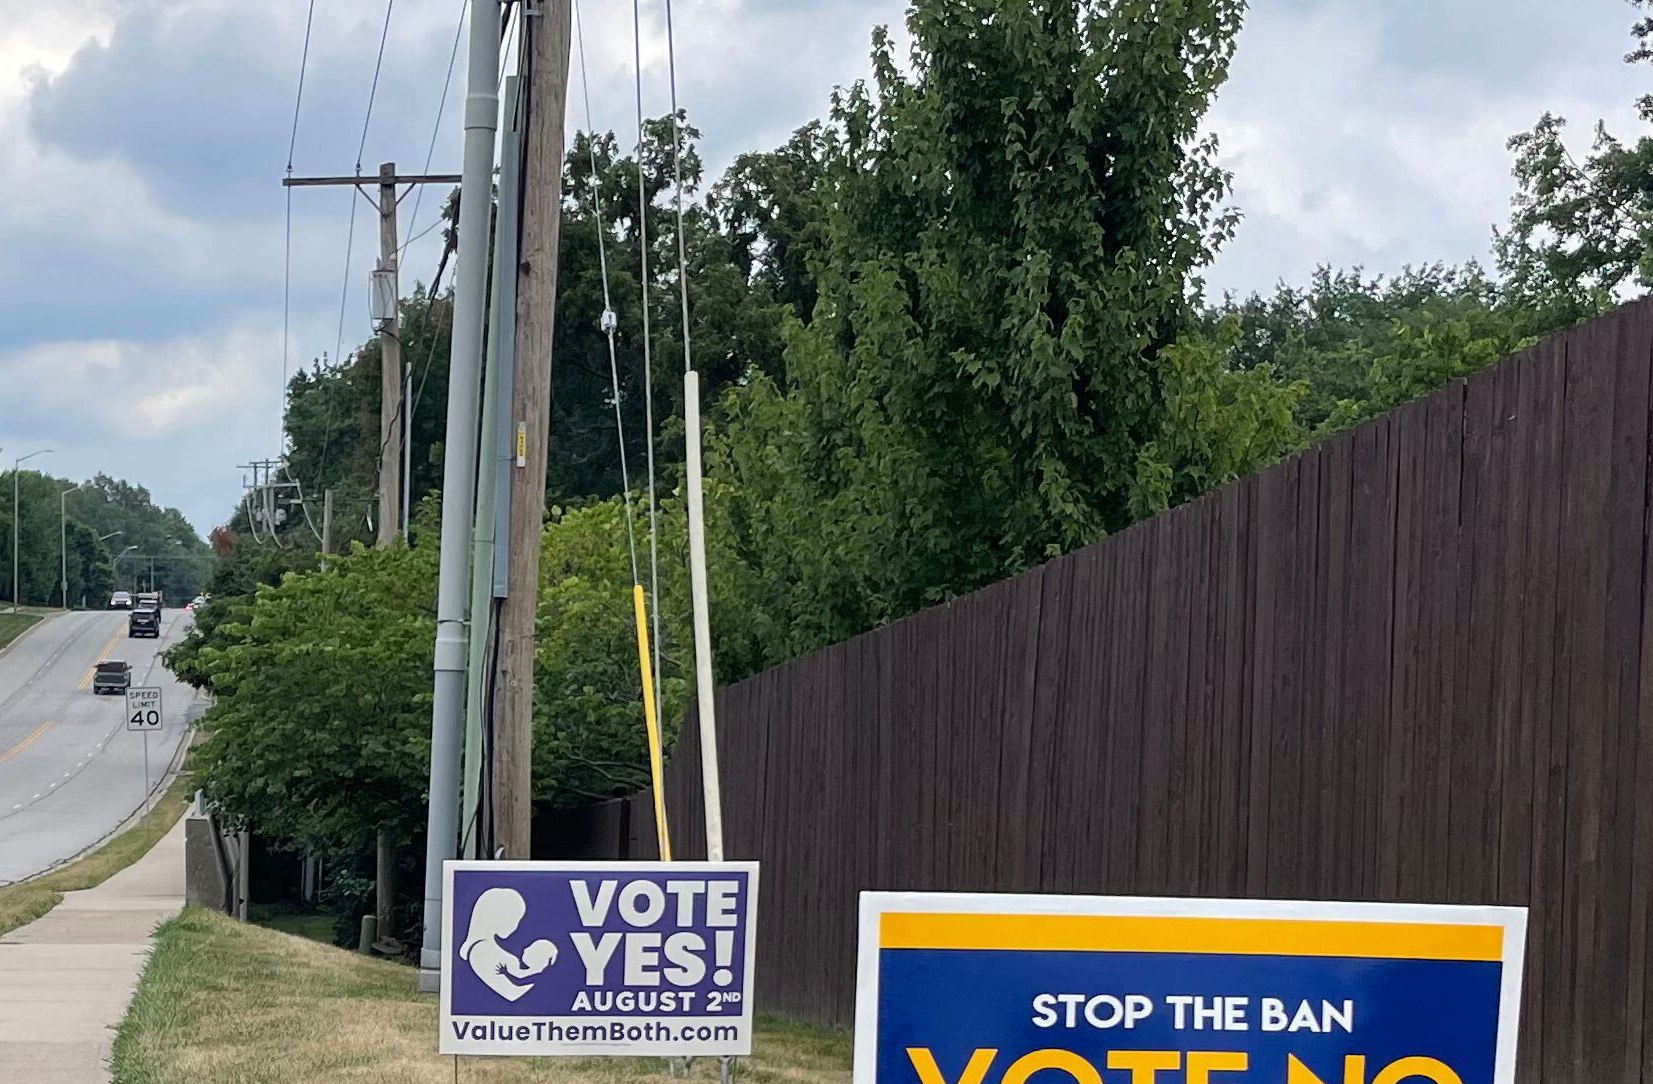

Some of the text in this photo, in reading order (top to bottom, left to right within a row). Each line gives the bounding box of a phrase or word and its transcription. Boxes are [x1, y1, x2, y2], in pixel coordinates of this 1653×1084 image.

[129, 691, 158, 699] SPEED
[132, 700, 156, 708] LIMIT
[130, 710, 159, 726] 40
[569, 879, 739, 927] VOTE
[569, 930, 734, 987] YES!
[571, 991, 696, 1012] AUGUST
[1031, 993, 1354, 1033] STOP THE BAN
[452, 1020, 739, 1042] ValueThemBoth.com
